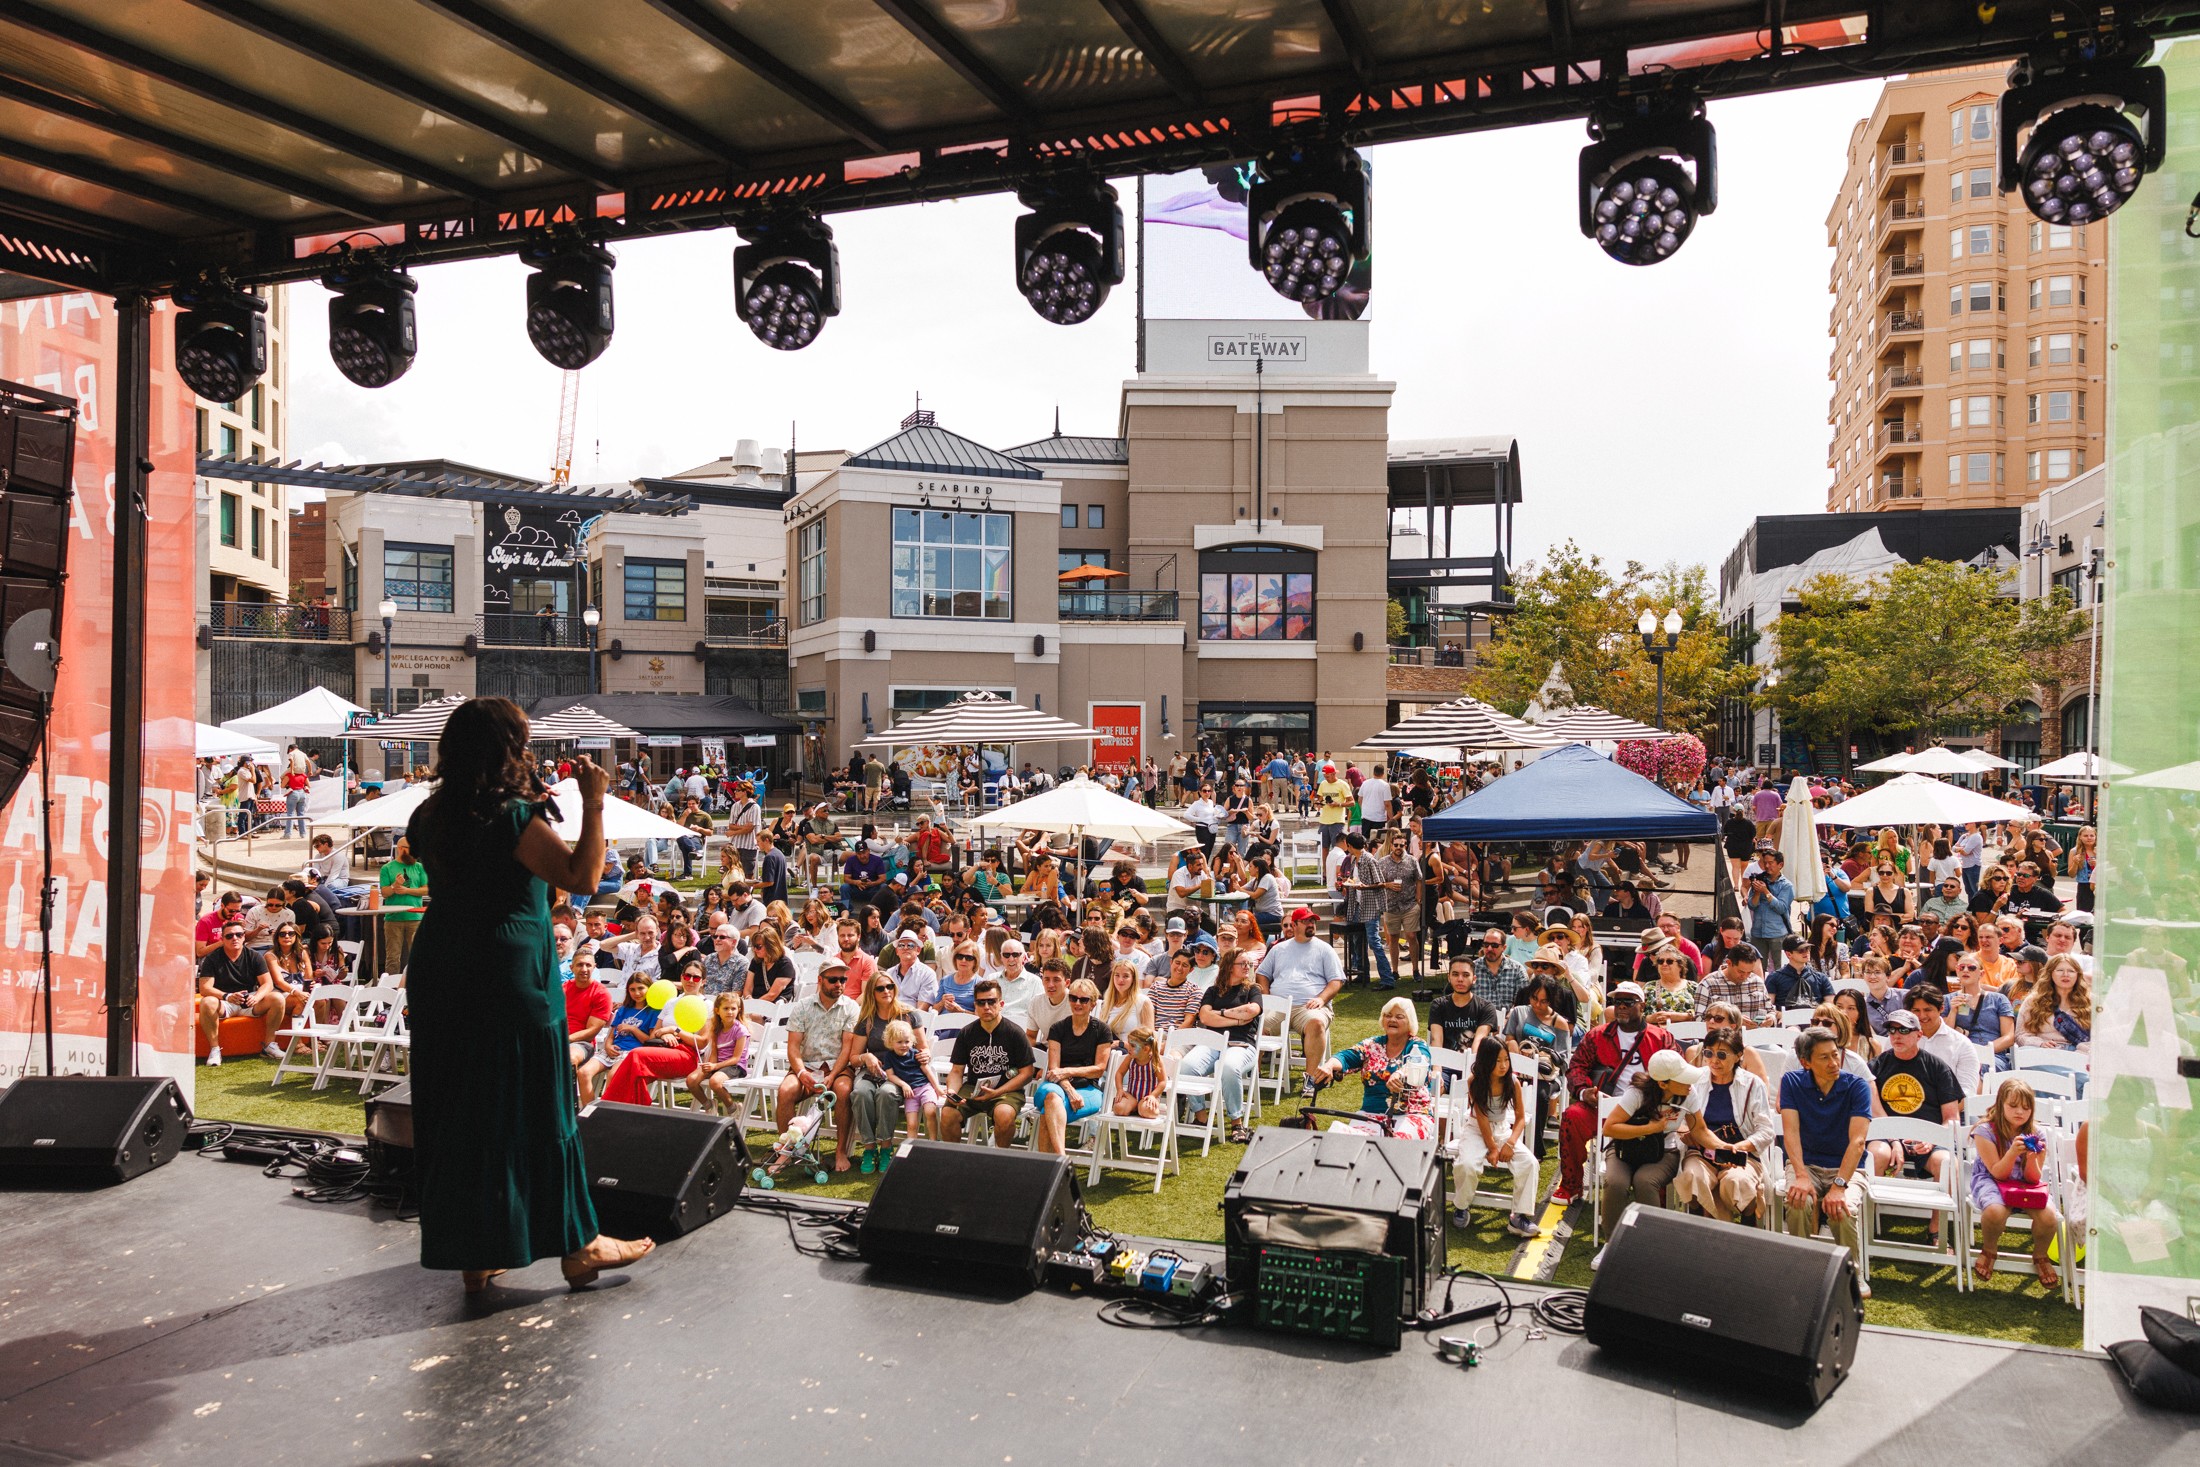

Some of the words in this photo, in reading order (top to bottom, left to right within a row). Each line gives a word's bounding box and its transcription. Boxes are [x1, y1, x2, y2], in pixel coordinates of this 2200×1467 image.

[1247, 332, 1268, 341] THE
[1213, 341, 1301, 356] GATEWAY
[917, 482, 993, 495] SEABIRD
[487, 545, 521, 570] Sky's
[522, 551, 540, 566] the
[1115, 726, 1130, 736] FULL
[1130, 726, 1139, 736] OF
[1099, 736, 1134, 747] SURPRISES
